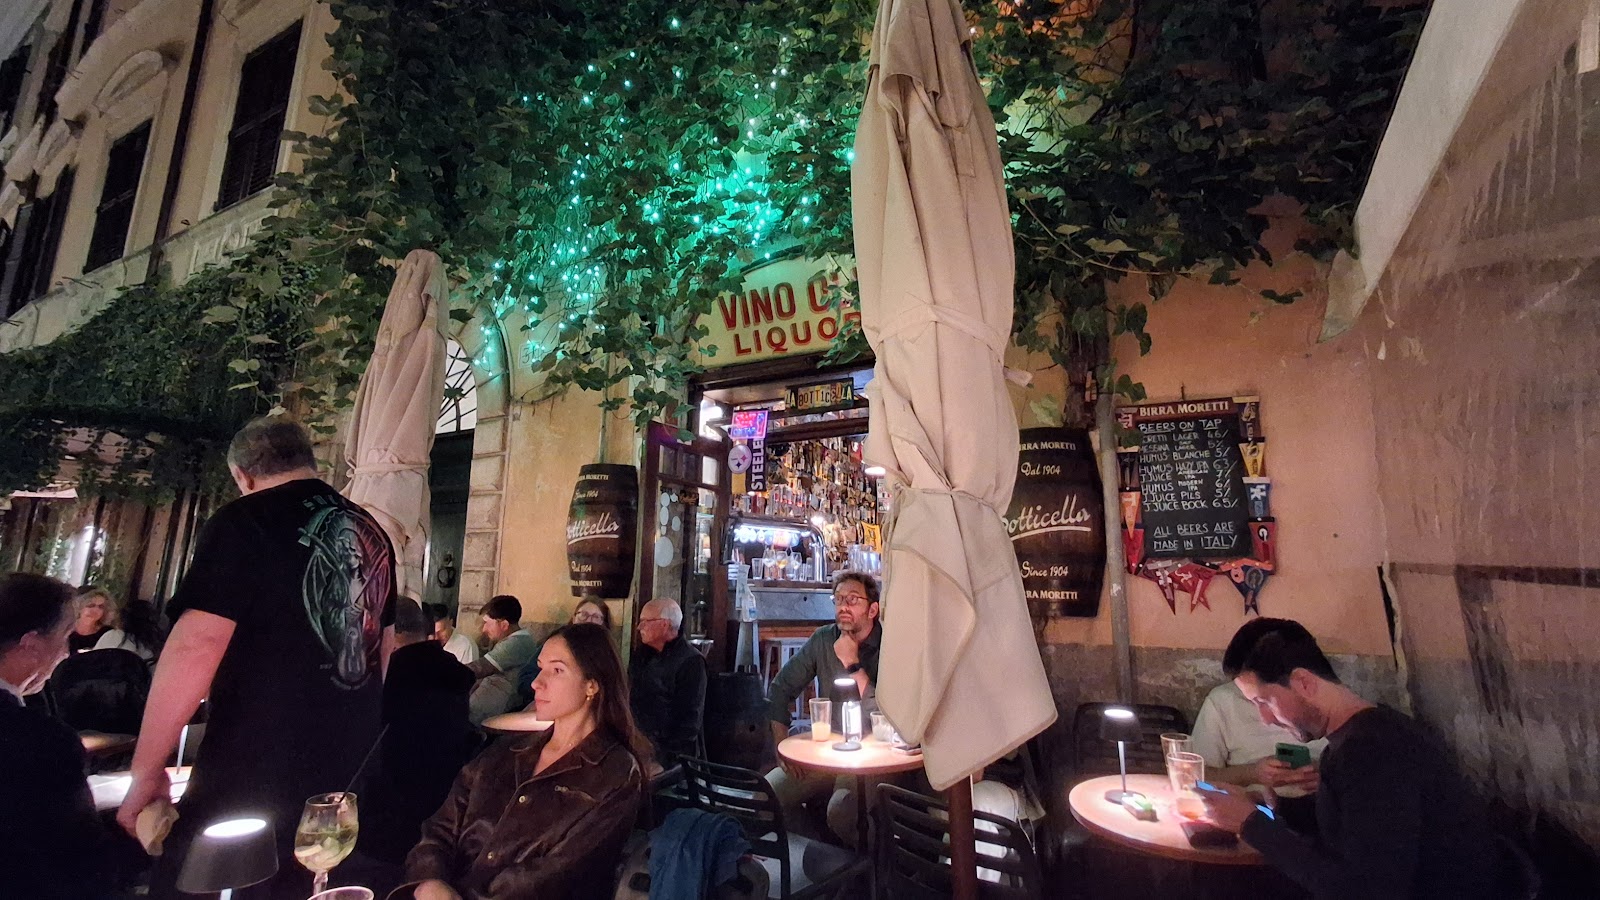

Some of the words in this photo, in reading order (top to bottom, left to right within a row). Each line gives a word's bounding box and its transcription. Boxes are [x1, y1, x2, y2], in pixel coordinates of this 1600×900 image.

[718, 282, 796, 331] VINO
[1139, 405, 1175, 417] BIRRA
[1177, 401, 1229, 414] MORETTI
[1138, 421, 1176, 432] BEERS
[1179, 421, 1195, 430] ON
[1198, 418, 1222, 429] TAP
[1172, 432, 1200, 441] LAGER
[1040, 441, 1076, 450] MORETTI
[751, 437, 764, 490] STEELE
[1139, 451, 1169, 463] HUMUS
[1172, 450, 1210, 461] BLANCHE
[1020, 461, 1041, 477] Dal
[1042, 464, 1061, 475] 1904
[1138, 463, 1173, 474] HUMUS
[1195, 460, 1210, 470] IPA
[1141, 482, 1174, 494] HUMUS
[1180, 491, 1201, 500] PILS
[1152, 501, 1180, 511] JUICE
[1181, 500, 1208, 510] BOCK
[1153, 525, 1173, 537] ALL
[1176, 522, 1209, 535] BEERS
[1213, 521, 1234, 532] ARE
[1153, 539, 1179, 550] MADE
[1183, 539, 1194, 549] IN
[1200, 534, 1238, 548] ITALY
[1020, 560, 1048, 578] Since
[1049, 565, 1069, 577] 1904
[1025, 590, 1039, 599] RA
[1040, 590, 1078, 600] MORETTI
